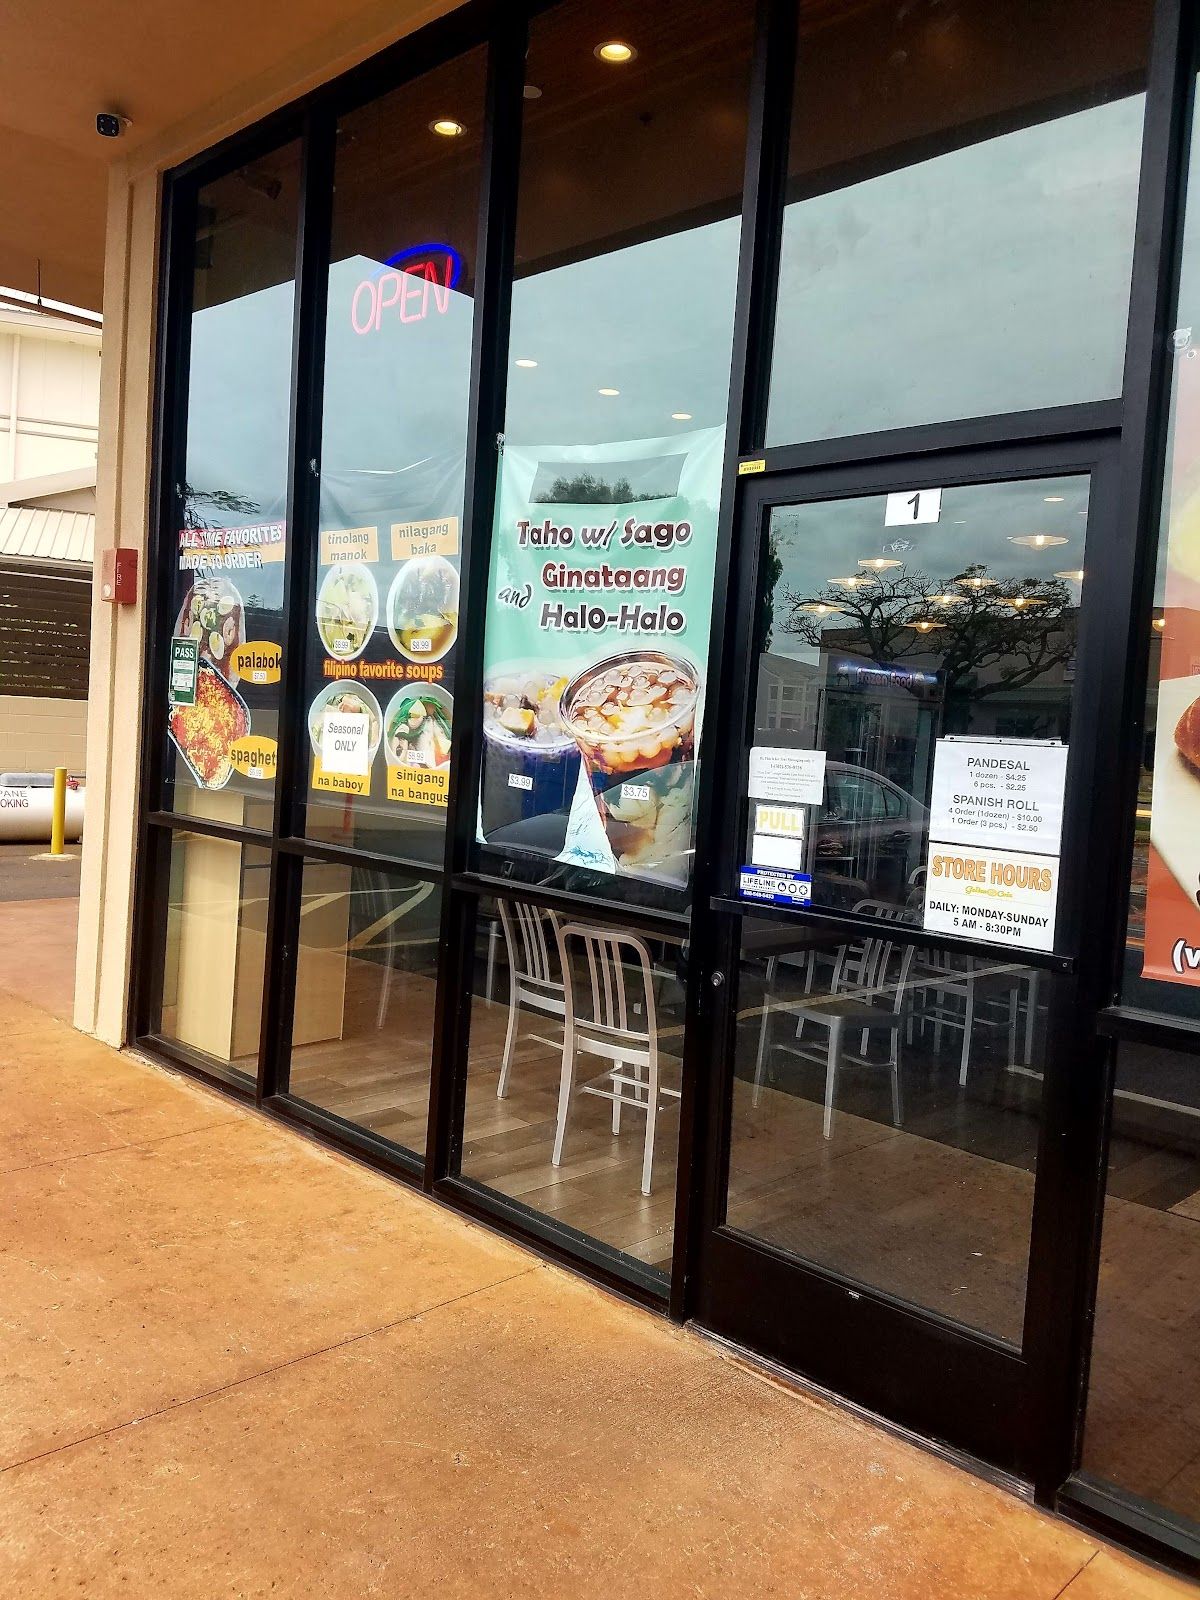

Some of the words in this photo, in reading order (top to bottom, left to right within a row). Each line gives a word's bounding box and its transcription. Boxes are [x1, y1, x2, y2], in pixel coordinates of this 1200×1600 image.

[351, 254, 453, 335] OPEN
[907, 492, 921, 520] 1
[180, 531, 199, 549] ALL
[223, 525, 282, 546] FAVORITES
[328, 532, 370, 545] tinolang
[399, 523, 449, 539] nilagang
[516, 519, 574, 546] Taho
[581, 520, 618, 547] w/
[620, 517, 692, 548] Sago
[330, 549, 367, 561] manok
[411, 543, 437, 556] baka
[179, 554, 208, 570] MADE
[209, 554, 222, 570] TO
[223, 552, 262, 570] ORDER
[542, 562, 685, 592] Ginataang
[497, 583, 533, 609] and
[174, 646, 195, 660] PASS
[237, 651, 281, 672] palabok
[323, 658, 357, 680] filipino
[359, 659, 404, 678] favorite
[406, 664, 444, 682] soups
[327, 722, 365, 736] Seasonal
[334, 739, 357, 752] ONLY
[230, 747, 277, 767] spaghet
[967, 757, 1031, 772] PANDESAL
[318, 776, 329, 787] na
[332, 776, 364, 793] baboy
[396, 769, 445, 786] sinigang
[509, 774, 531, 788] $3.99
[975, 771, 998, 780] dozen
[1005, 773, 1027, 782] $4.25
[622, 784, 649, 799] $3.75
[973, 780, 979, 788] 6
[980, 782, 996, 790] pcs.
[1005, 783, 1027, 791] $2.25
[391, 787, 405, 799] na
[408, 787, 449, 804] bangus
[952, 794, 1004, 808] SPANISH
[1006, 799, 1040, 812] ROLL
[759, 810, 800, 832] PULL
[954, 807, 976, 816] Order
[977, 809, 1010, 820] (1dozen)
[1016, 813, 1043, 823] $10.00
[957, 817, 979, 826] Order
[980, 819, 987, 828] (3
[988, 821, 1008, 830] pcs.)
[1016, 823, 1039, 832] $2.50
[743, 876, 776, 888] LIFELINE
[932, 855, 987, 882] STORE
[990, 862, 1053, 892] HOURS
[929, 900, 960, 914] DAILY:
[962, 905, 1049, 928] MONDAY-SUNDAY
[953, 917, 959, 927] 5
[961, 918, 977, 930] AM
[985, 922, 1021, 937] 8:30PM
